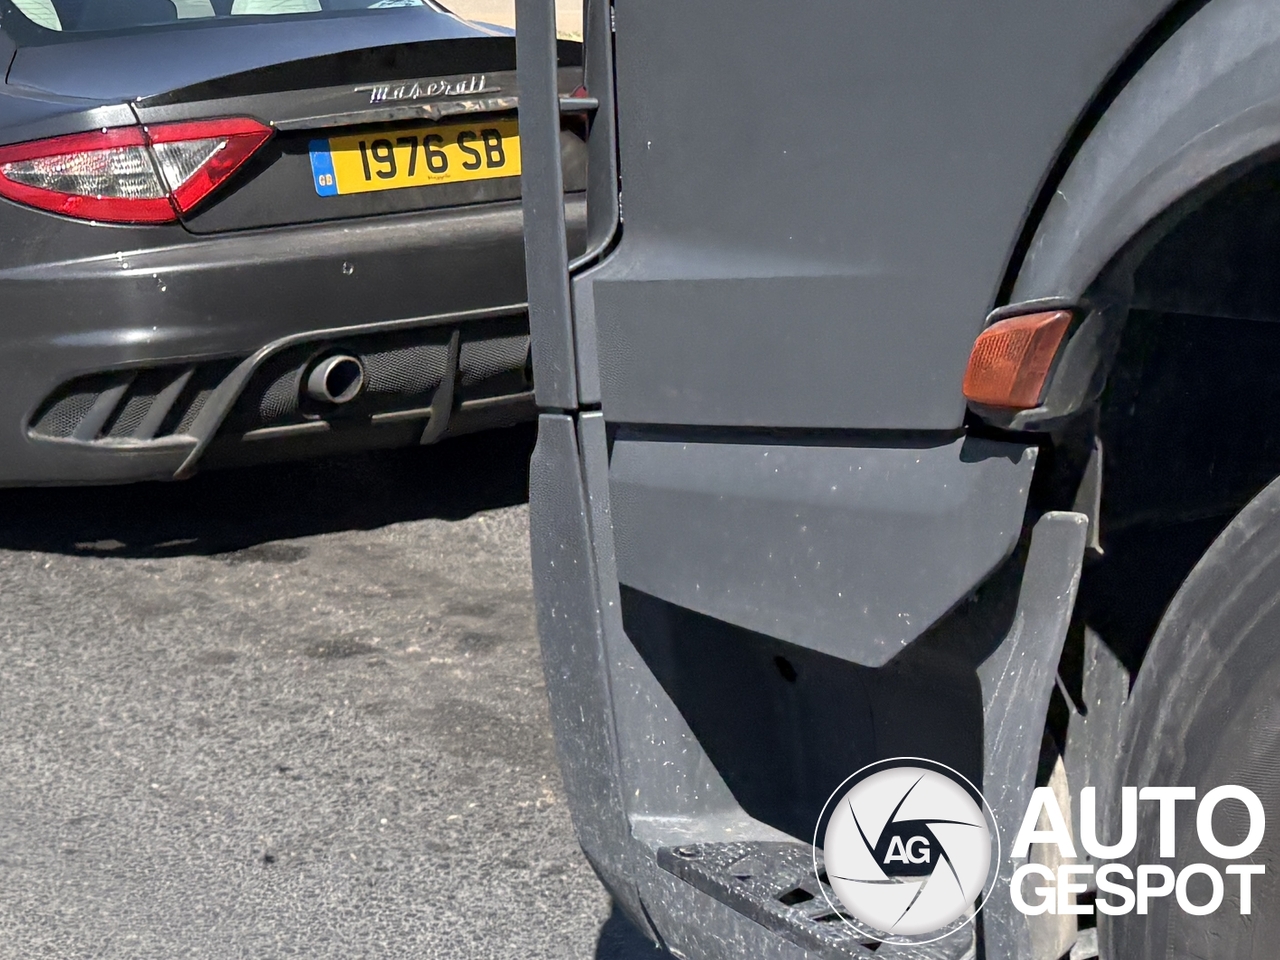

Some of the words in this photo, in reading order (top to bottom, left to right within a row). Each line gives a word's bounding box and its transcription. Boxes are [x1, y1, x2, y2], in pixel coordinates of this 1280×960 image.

[358, 133, 448, 181] 1976
[456, 128, 506, 171] SB
[318, 173, 333, 186] GB
